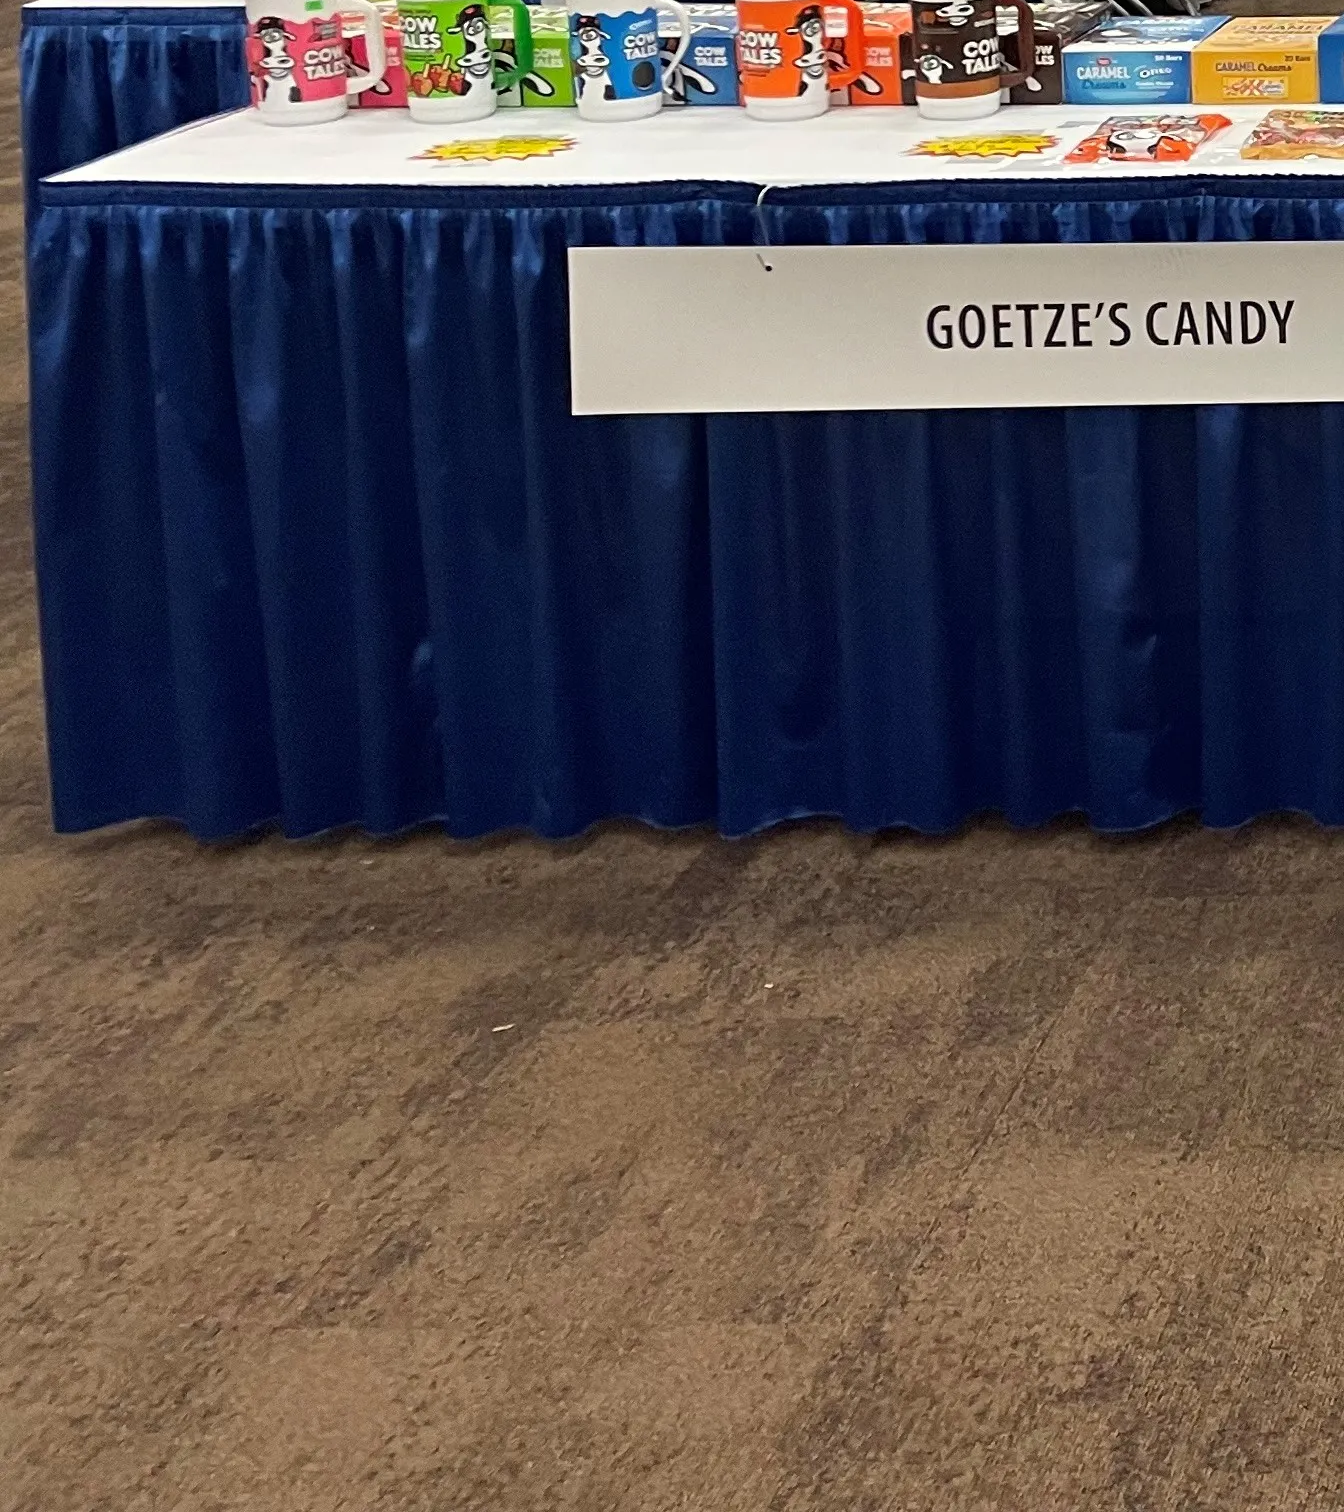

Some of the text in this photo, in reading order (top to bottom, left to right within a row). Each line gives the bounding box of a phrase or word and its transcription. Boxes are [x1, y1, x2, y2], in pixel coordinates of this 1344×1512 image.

[404, 33, 442, 50] ALES
[624, 31, 656, 47] COW
[533, 47, 562, 59] COW
[694, 46, 727, 58] COW
[963, 39, 999, 59] COW
[304, 47, 344, 65] COW
[694, 56, 728, 68] TALES
[1034, 55, 1055, 66] LES
[532, 57, 564, 69] TALES
[1215, 62, 1256, 72] CARAMEL
[1076, 67, 1131, 80] CARAMEL
[926, 299, 1295, 350] GOETZE'S CANDY
